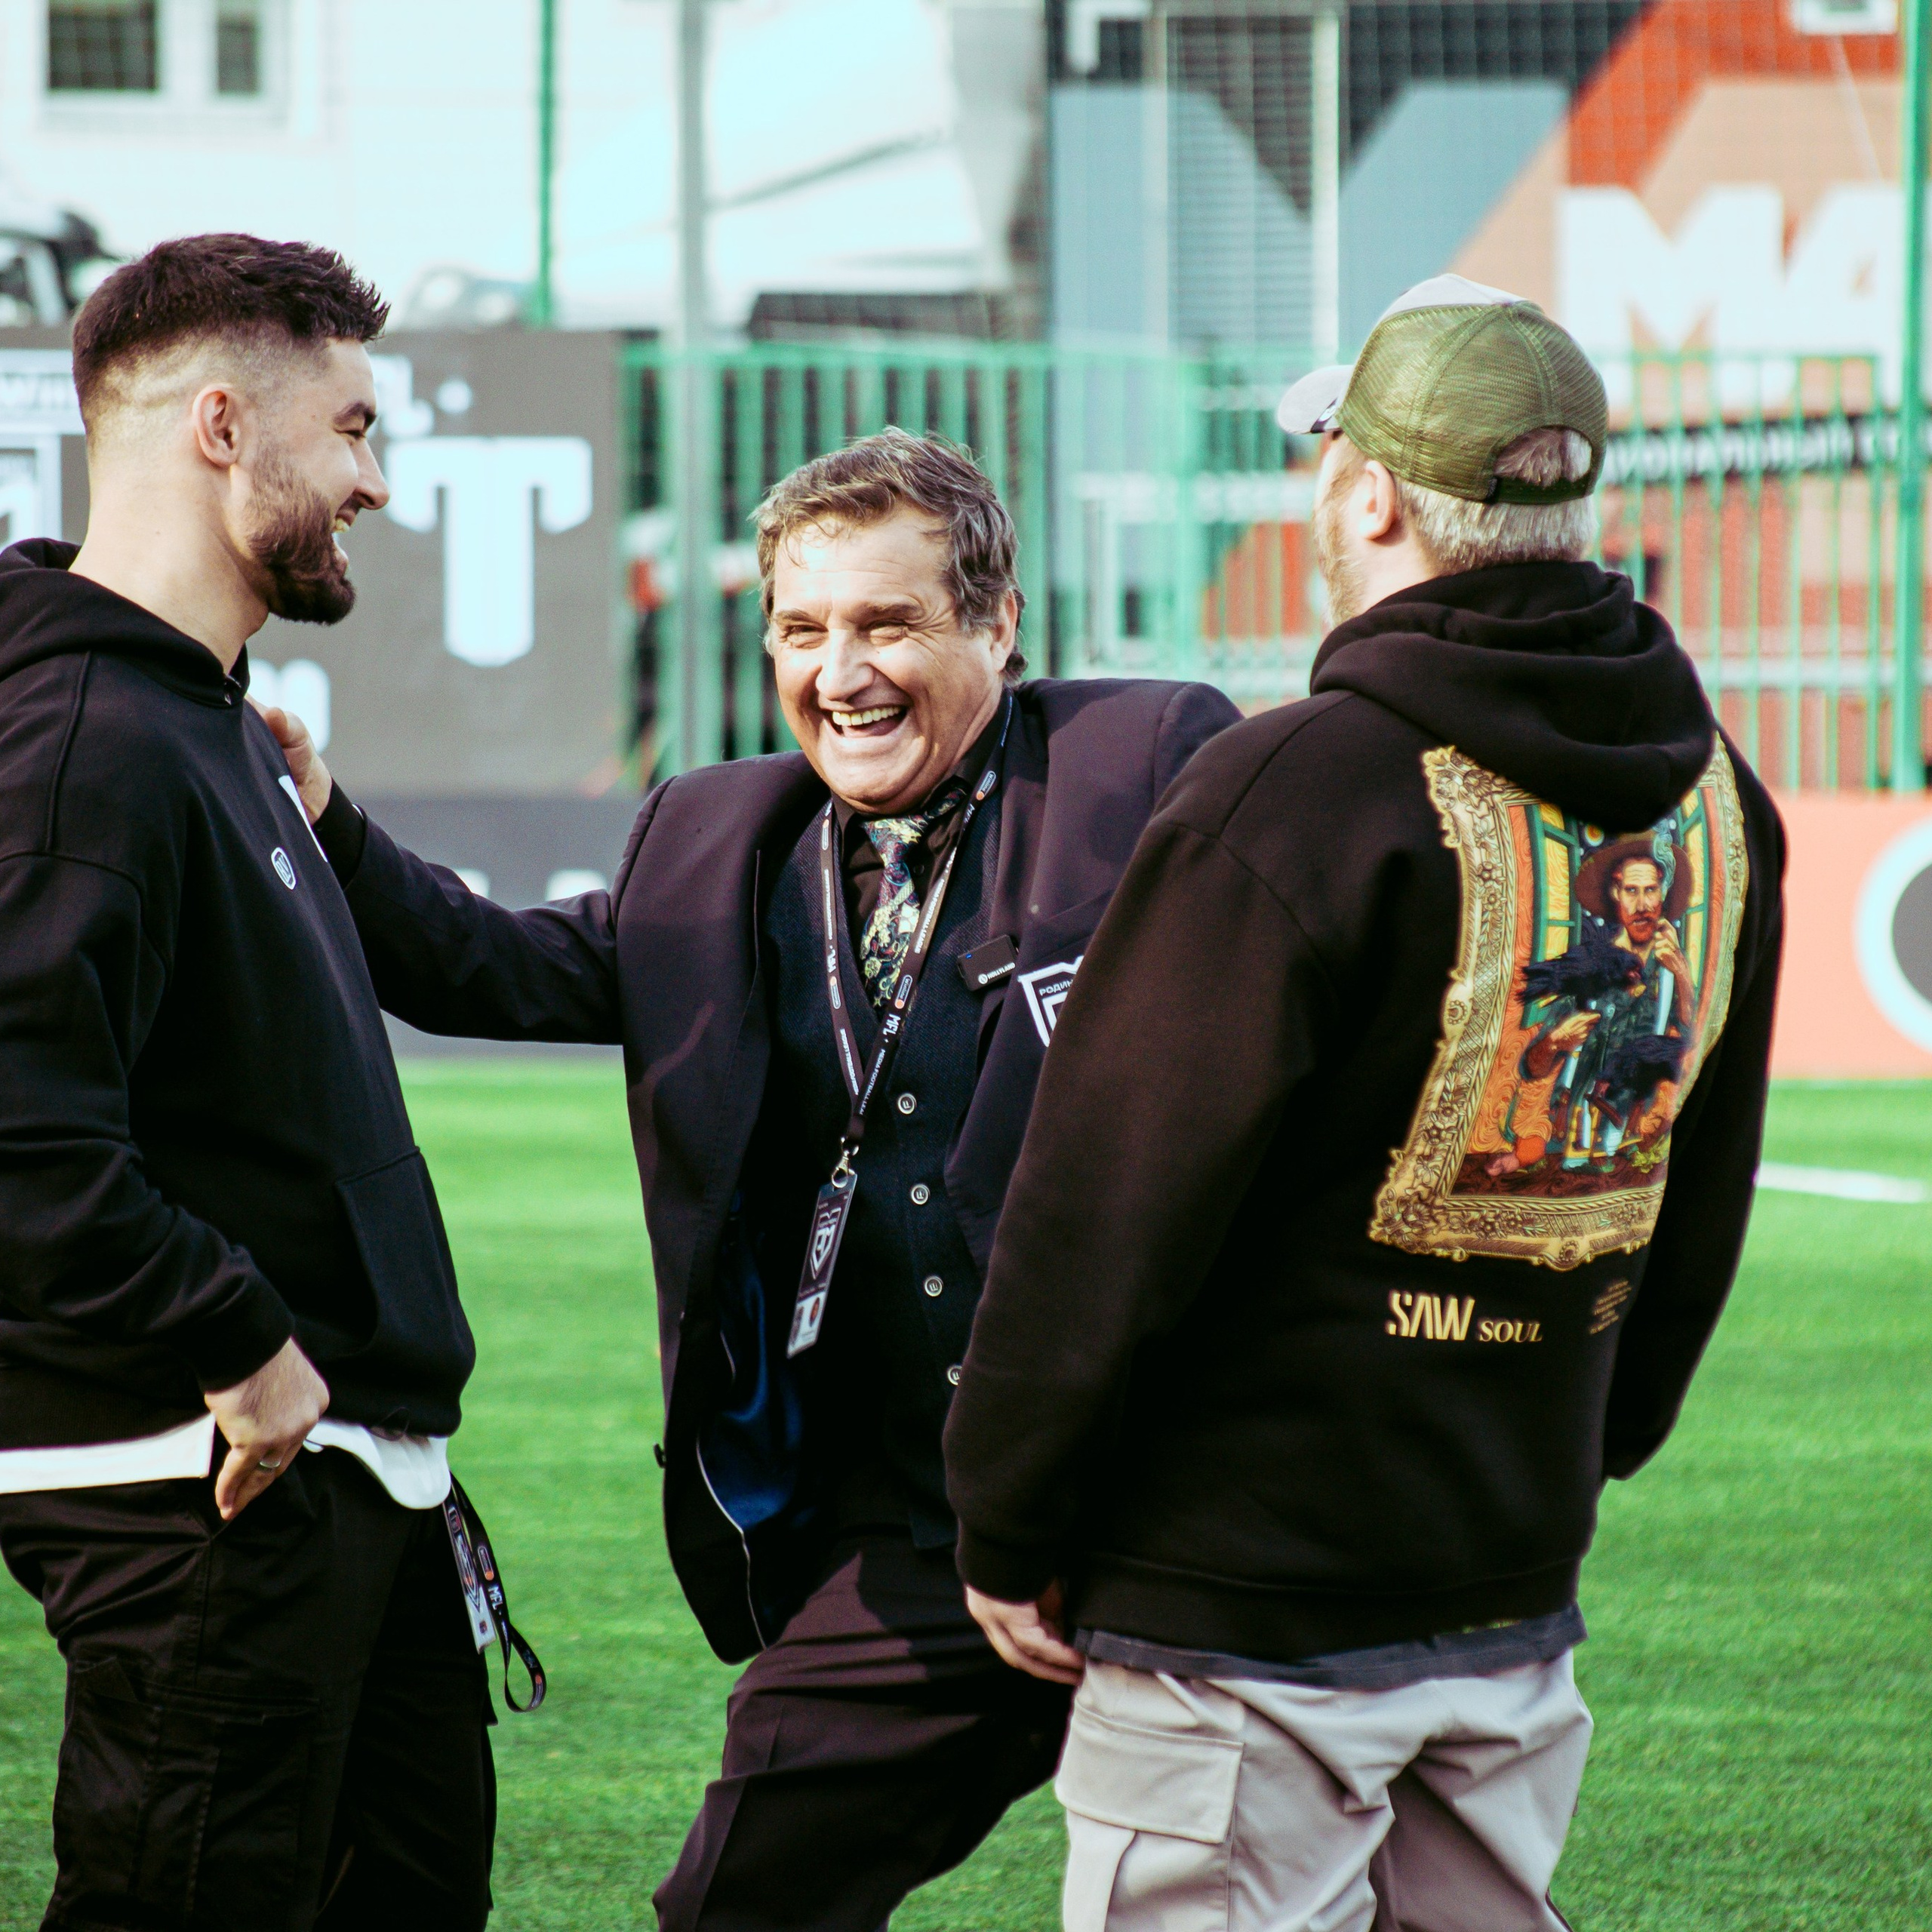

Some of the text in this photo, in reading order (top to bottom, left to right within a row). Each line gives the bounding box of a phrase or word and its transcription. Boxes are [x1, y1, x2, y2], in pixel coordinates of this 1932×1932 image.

[921, 897, 937, 930] FOOTBALL
[914, 928, 927, 954] LEAGUE
[987, 961, 1016, 980] HOLLYLAND
[899, 977, 910, 999] Winline
[882, 1014, 901, 1036] MFL
[875, 1048, 885, 1069] MEDIA
[863, 1069, 878, 1100] FOOTBALL
[1386, 1290, 1543, 1343] SAW SOUL
[488, 1586, 503, 1611] MFL
